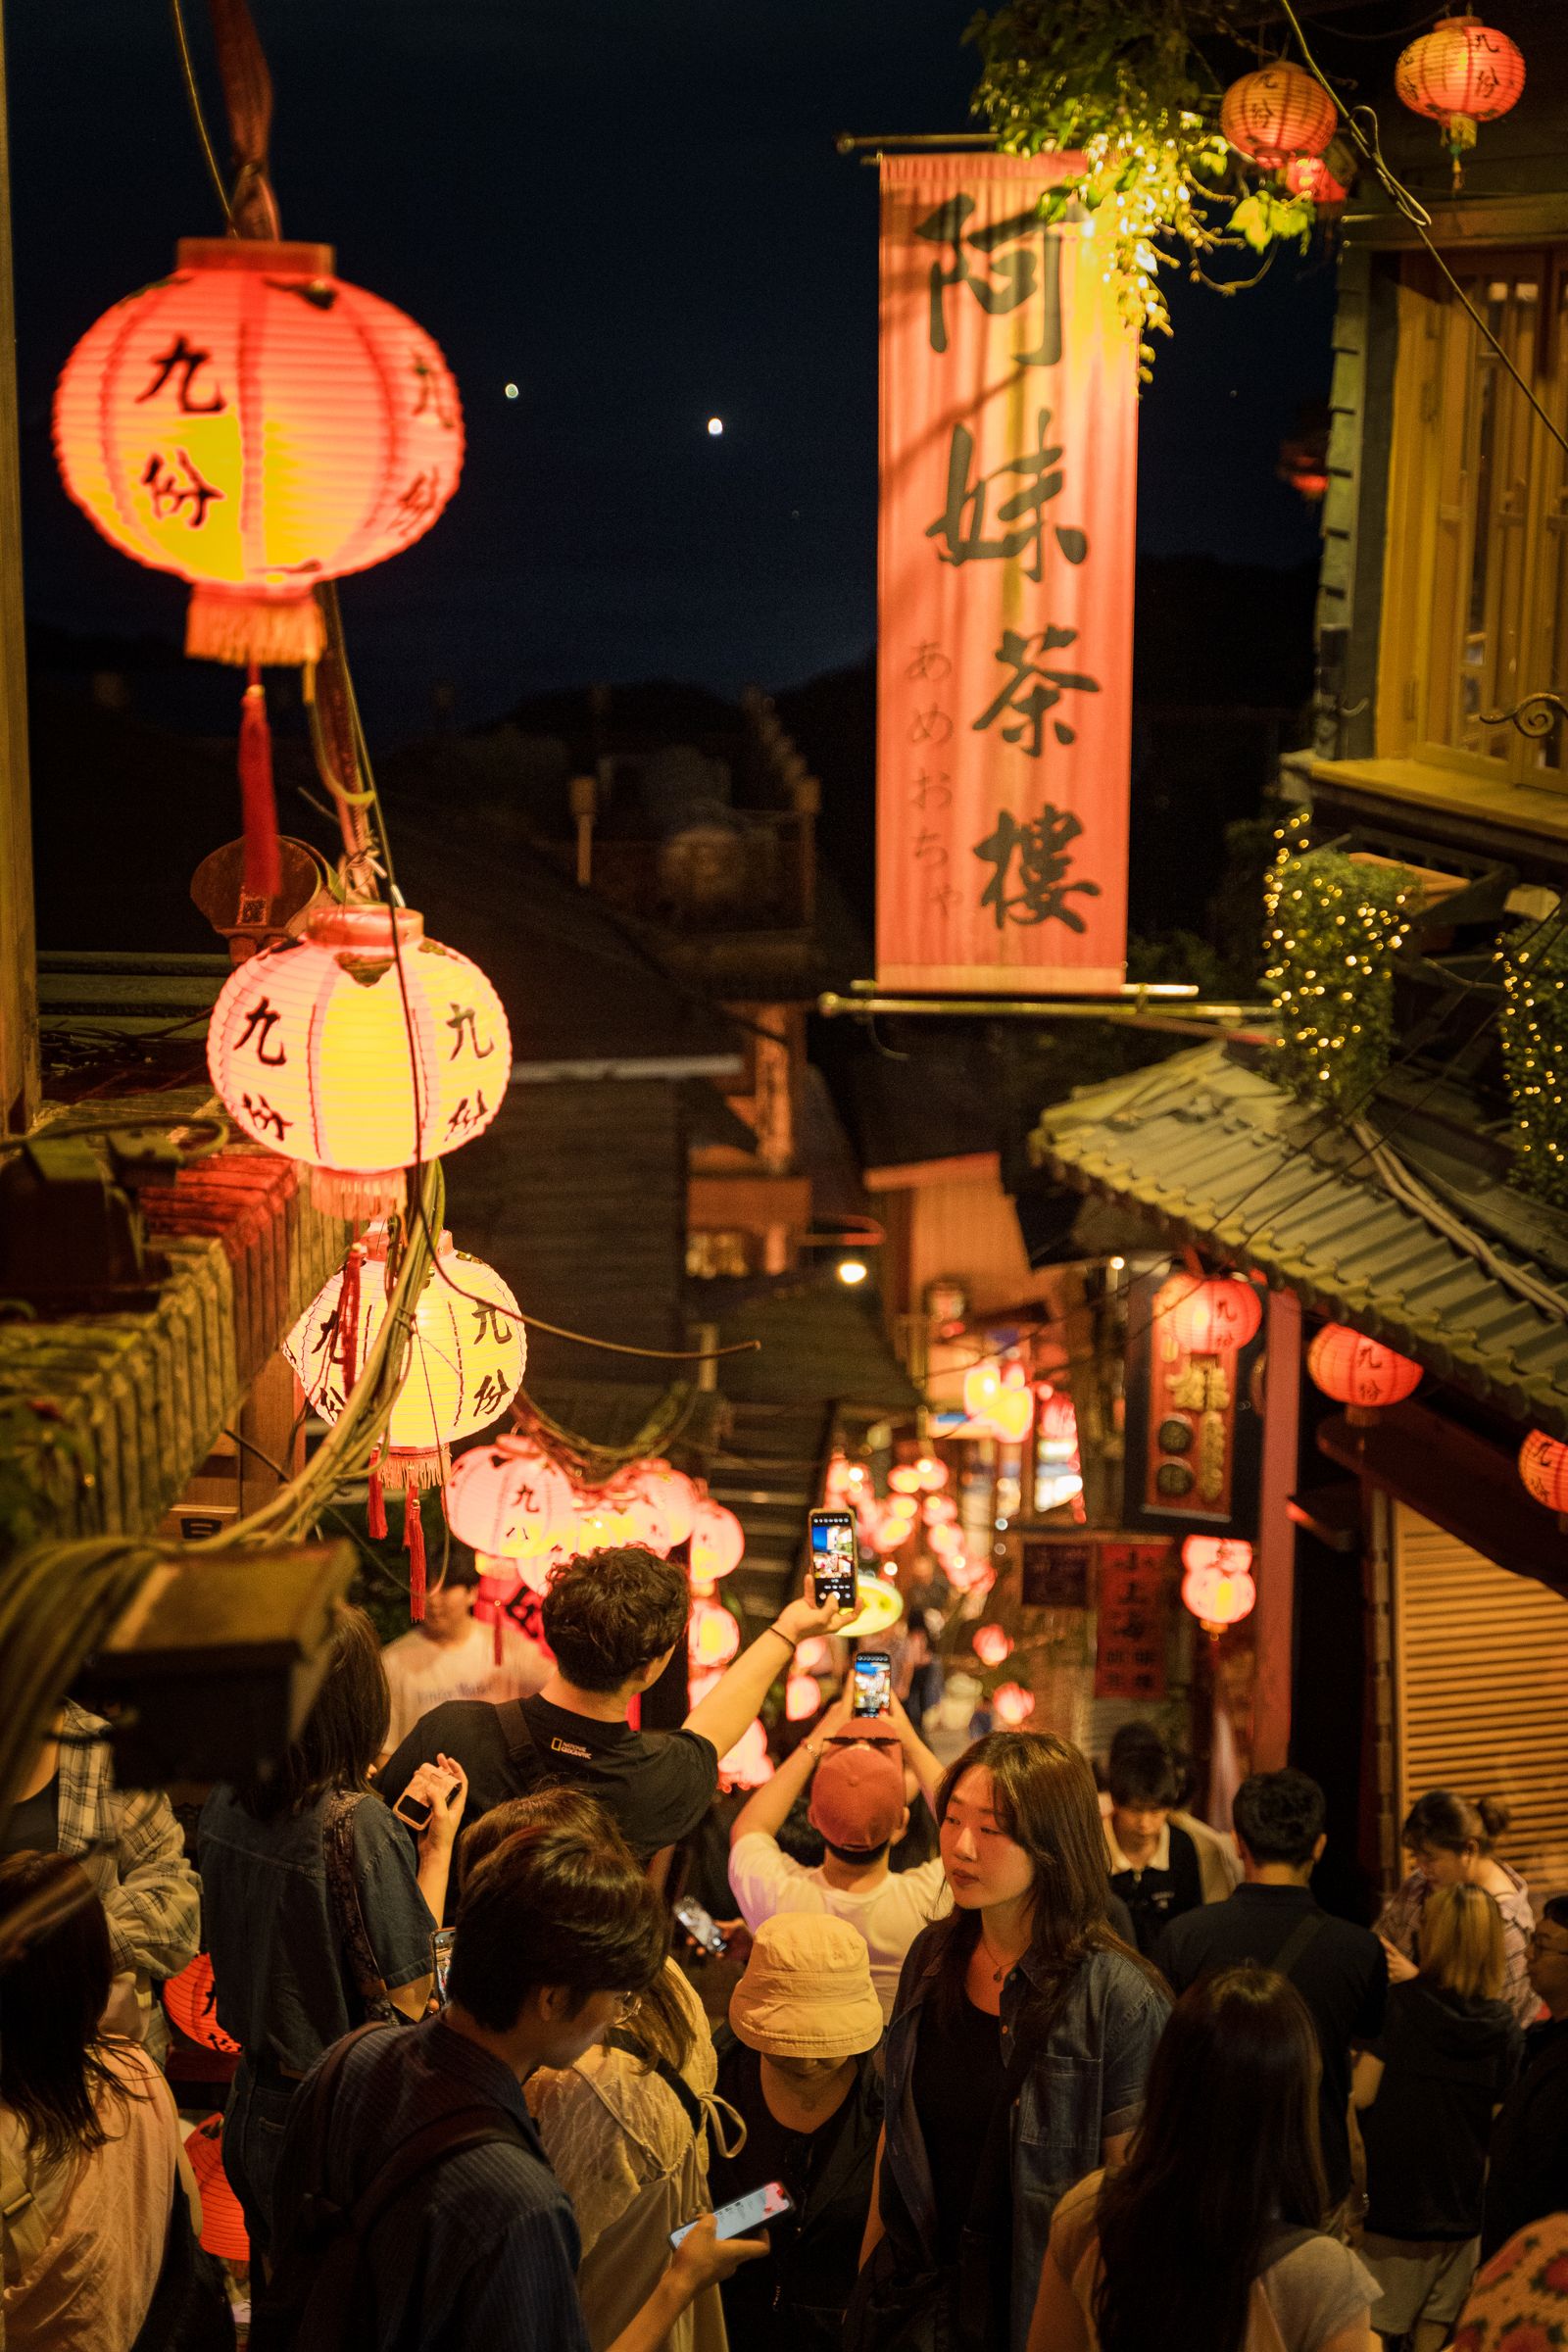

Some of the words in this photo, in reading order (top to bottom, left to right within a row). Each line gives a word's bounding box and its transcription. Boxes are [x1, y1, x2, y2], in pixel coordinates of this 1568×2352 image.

[135, 334, 226, 529] 九份
[915, 186, 1102, 934] 阿妹茶樓
[233, 996, 294, 1142] 九份
[444, 1002, 495, 1142] 九份
[471, 1298, 514, 1417] 九份
